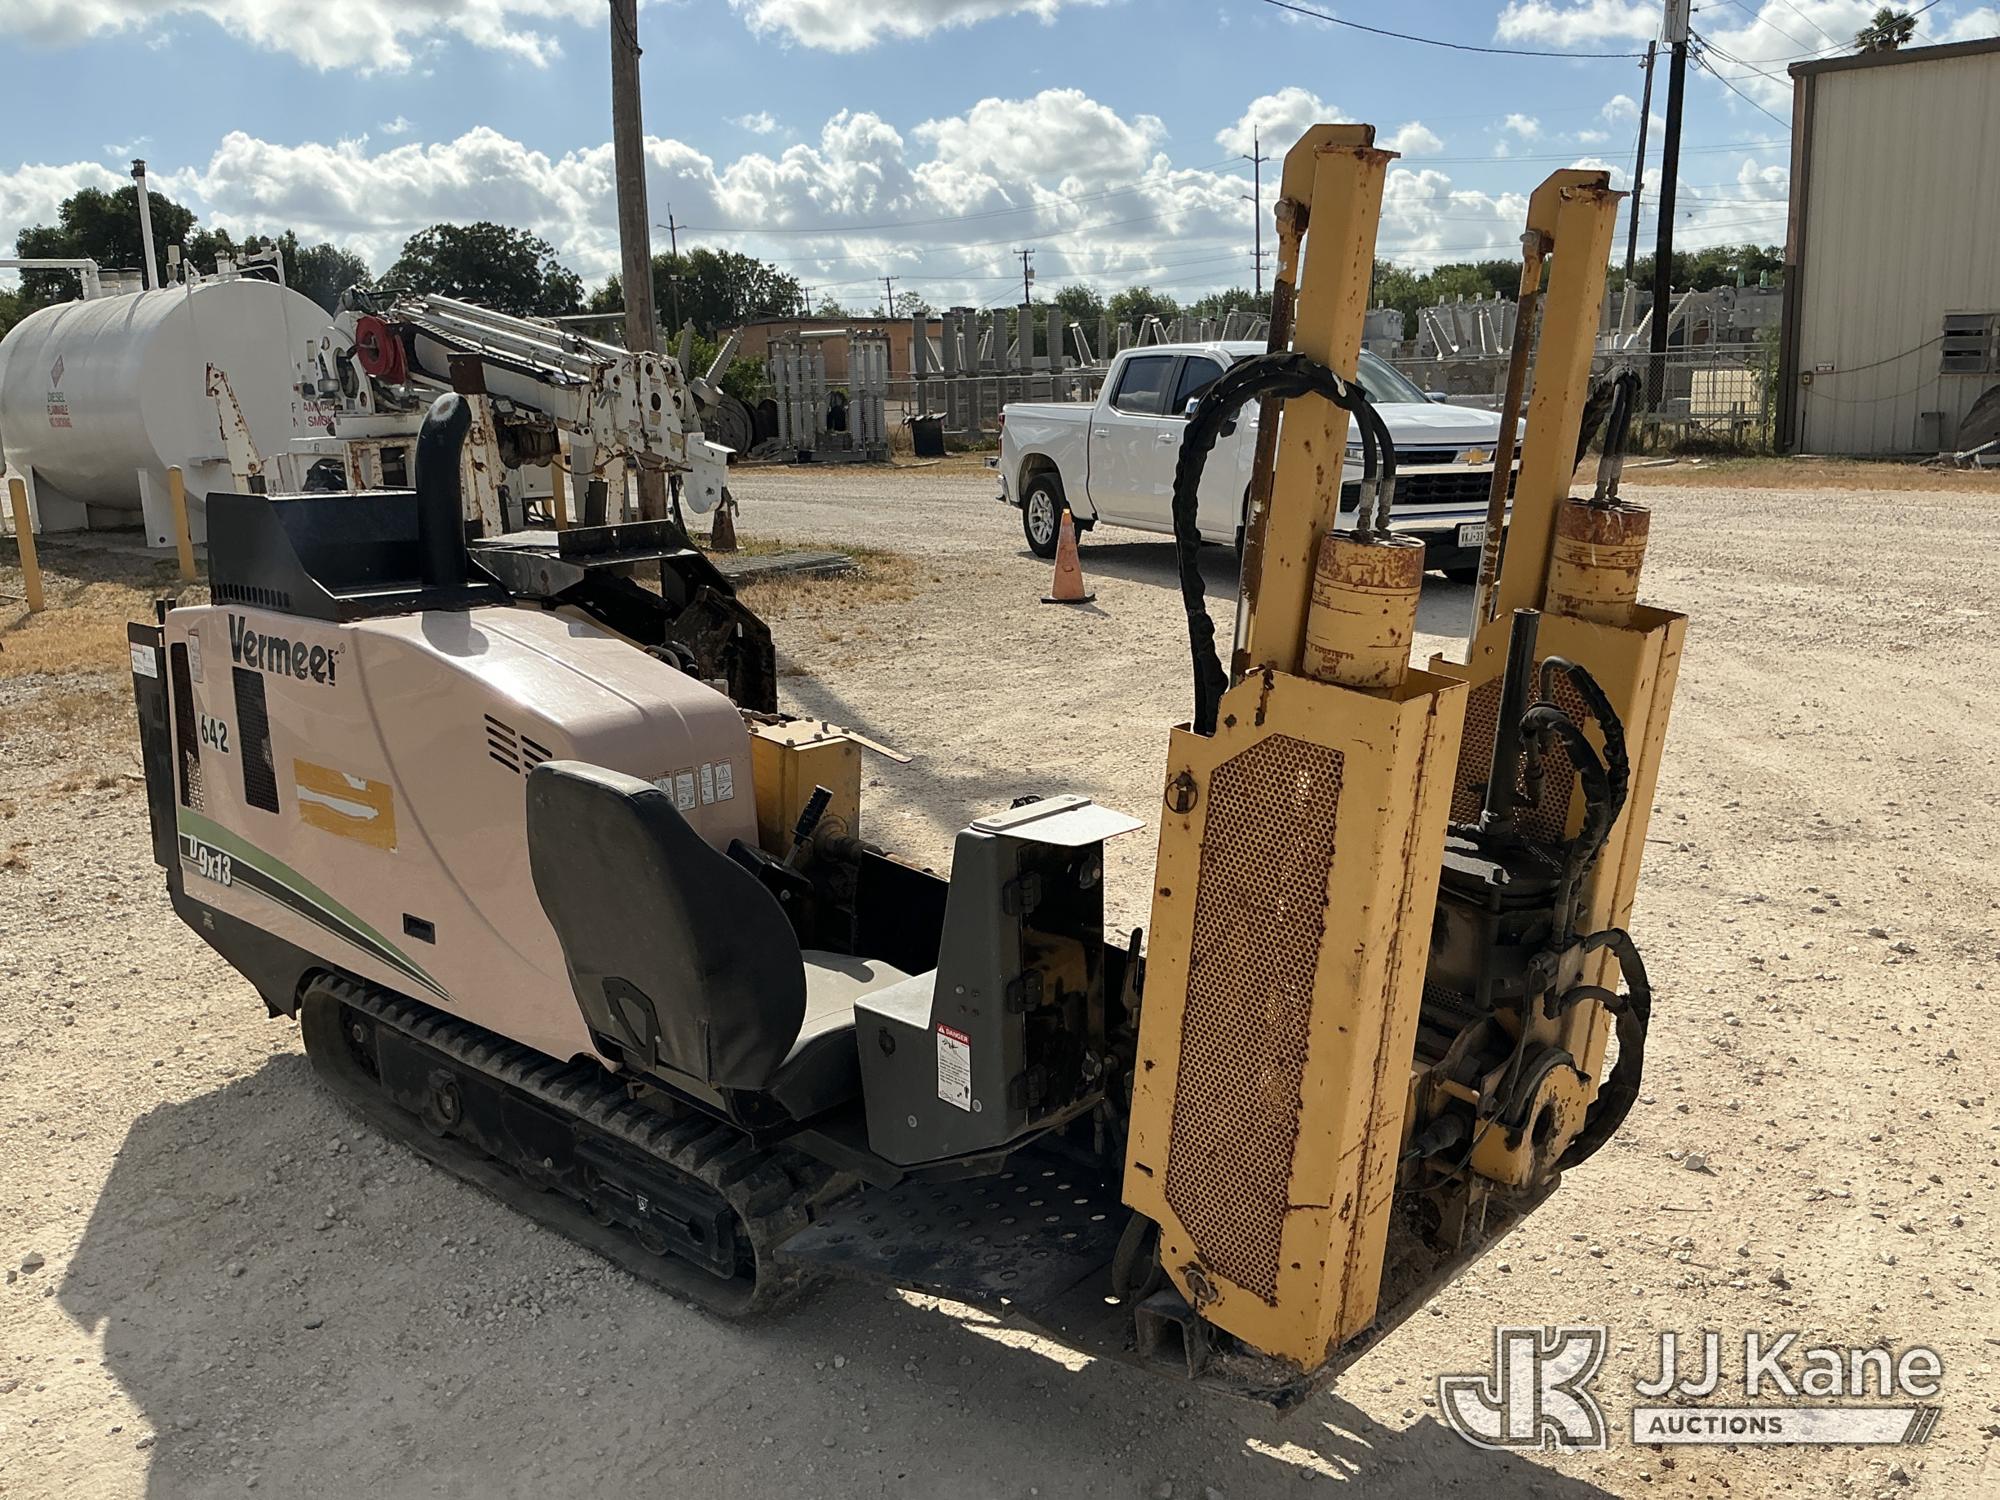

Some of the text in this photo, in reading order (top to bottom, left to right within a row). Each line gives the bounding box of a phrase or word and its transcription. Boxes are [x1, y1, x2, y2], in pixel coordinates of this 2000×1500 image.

[228, 613, 339, 687] Vermeer
[201, 714, 229, 753] 642
[945, 1028, 969, 1043] DANGER
